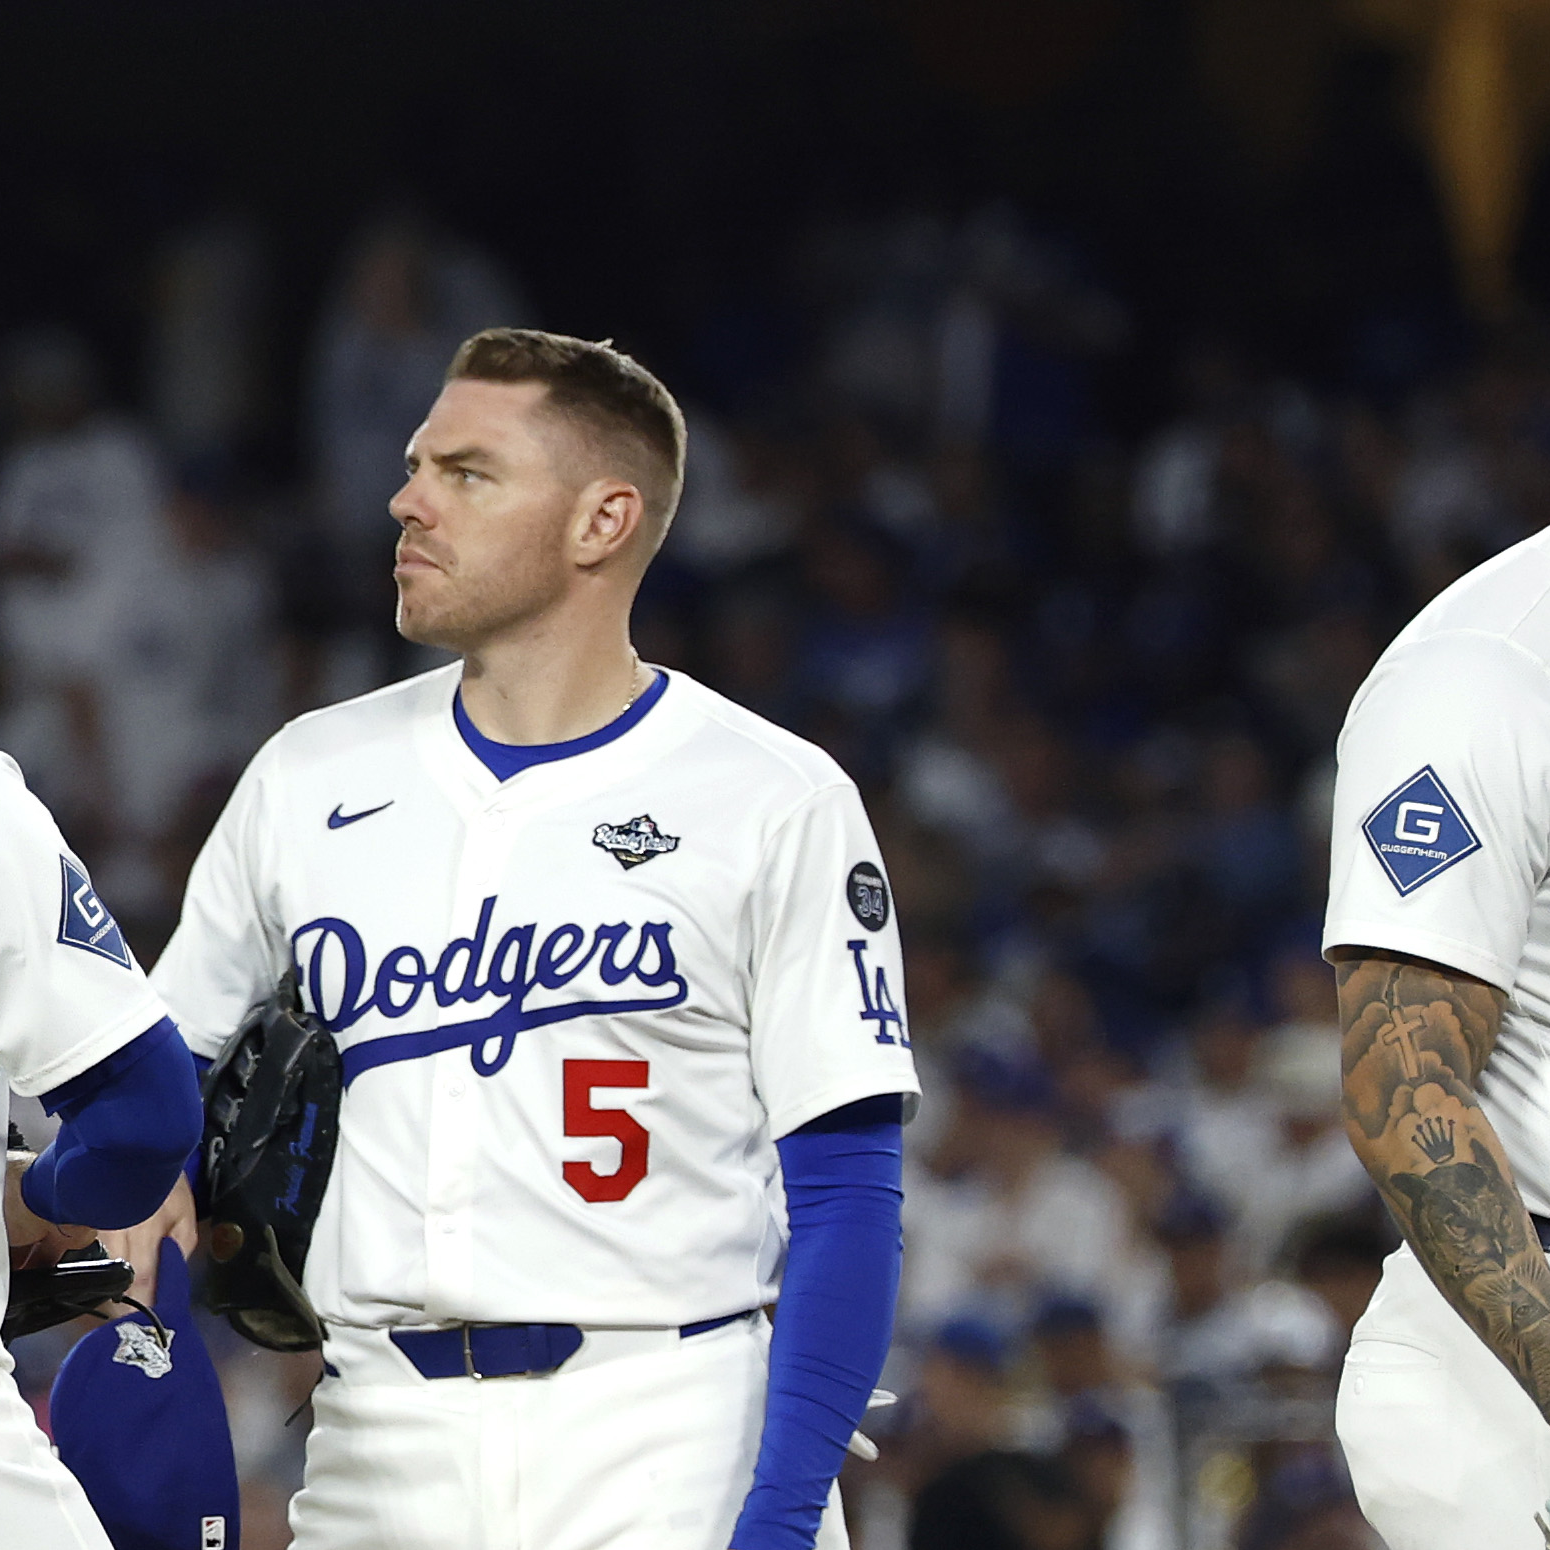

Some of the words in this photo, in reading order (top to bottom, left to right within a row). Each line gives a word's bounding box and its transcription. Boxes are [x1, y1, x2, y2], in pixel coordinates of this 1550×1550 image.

[1380, 844, 1448, 860] GUGGENHEIM
[1394, 801, 1444, 844] G
[72, 882, 105, 928] G
[292, 895, 688, 1082] Dodgers
[847, 940, 913, 1049] LA
[562, 1058, 649, 1202] 5
